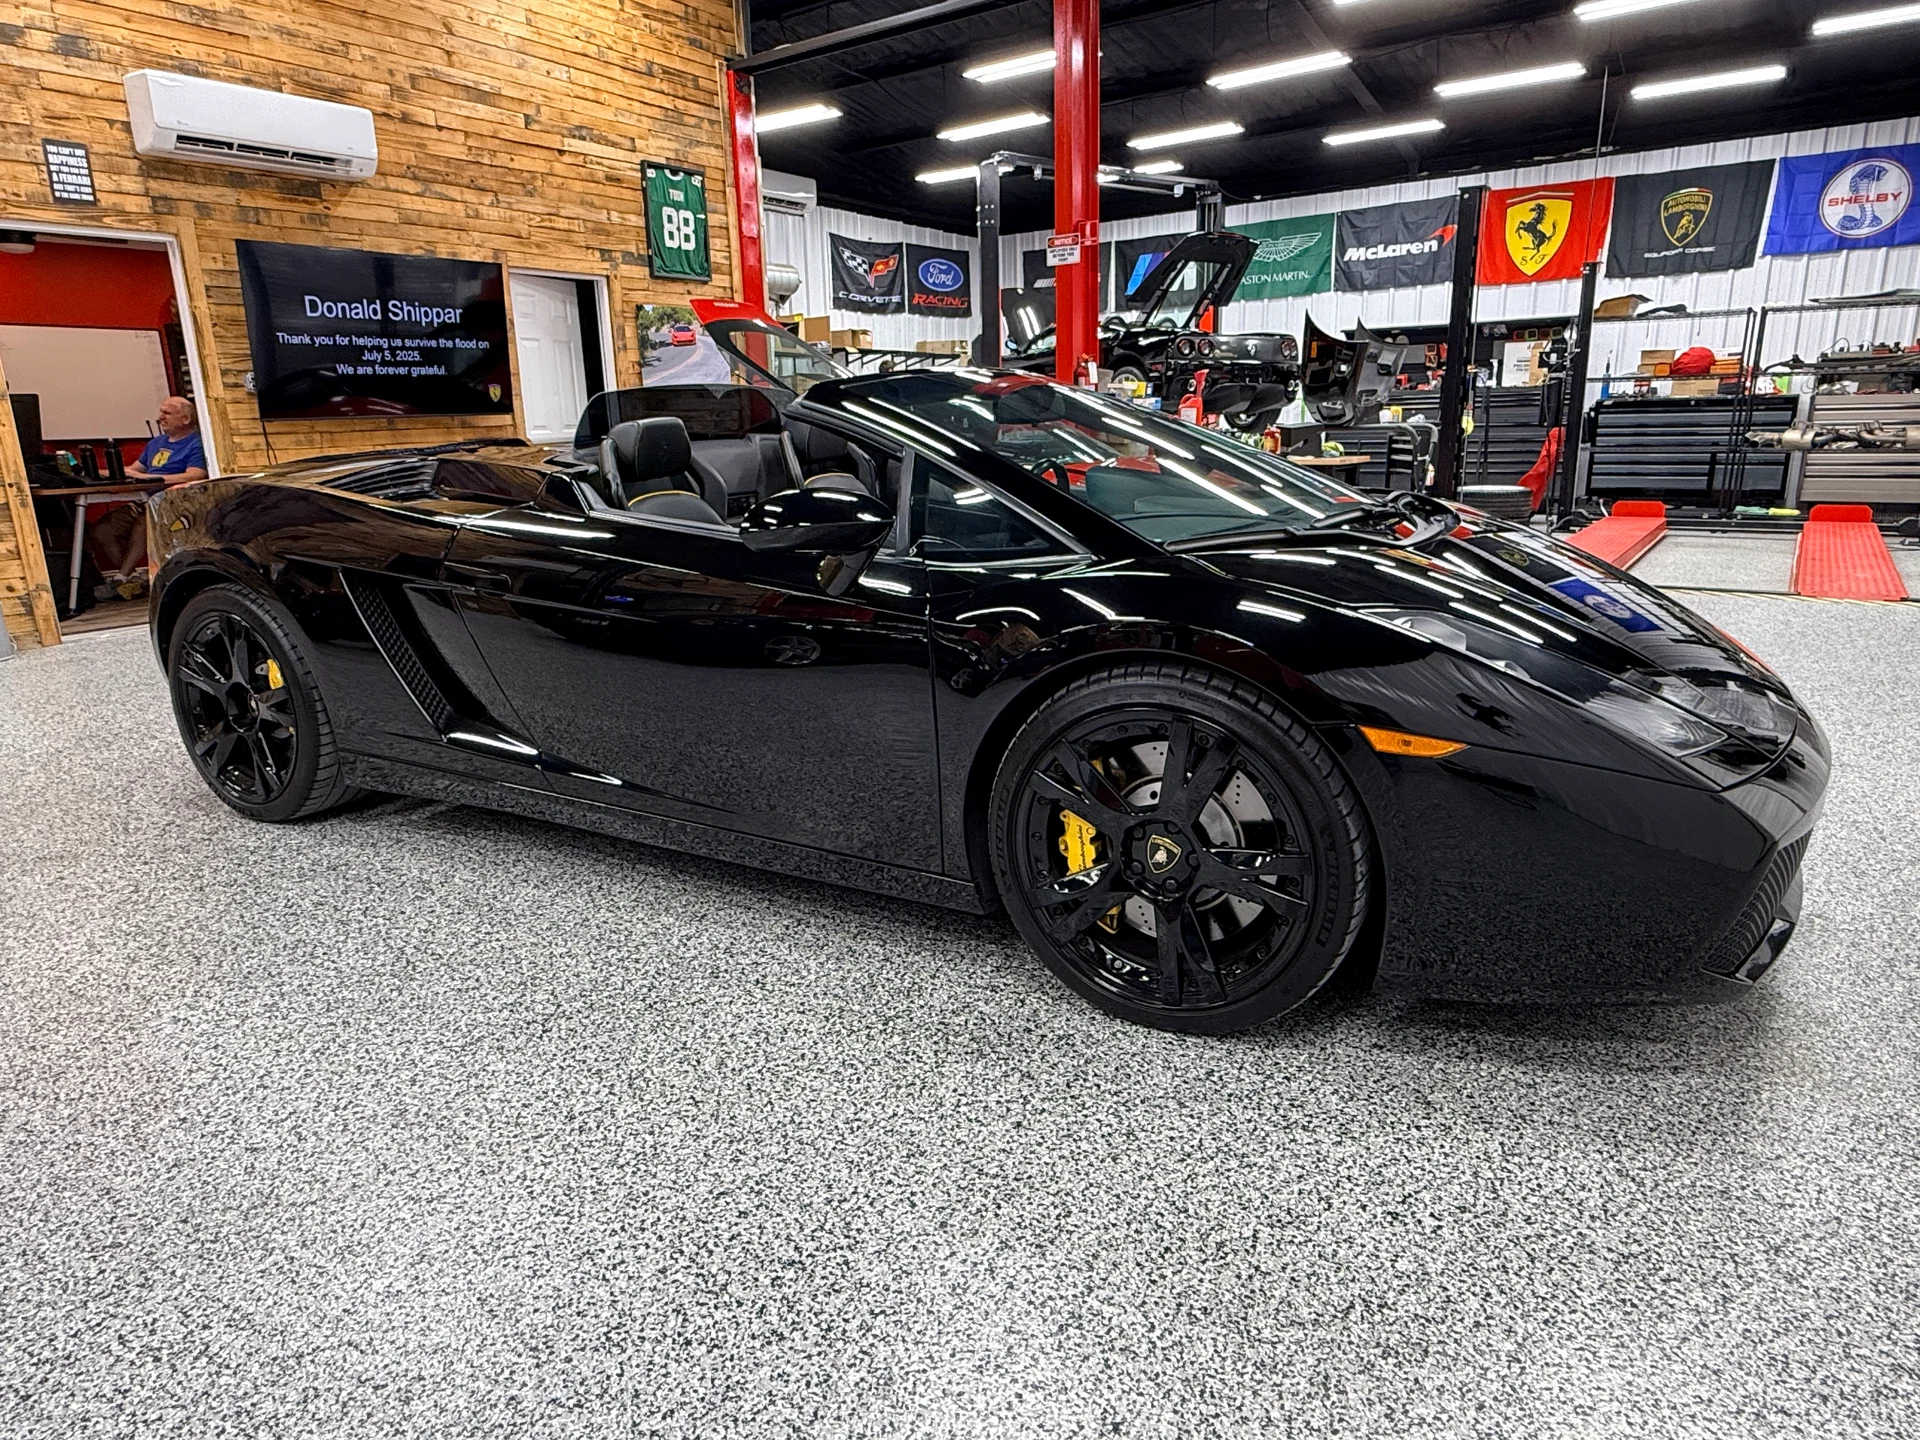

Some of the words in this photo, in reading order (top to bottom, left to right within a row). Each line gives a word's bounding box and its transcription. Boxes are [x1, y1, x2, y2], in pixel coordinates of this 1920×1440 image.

[48, 154, 88, 168] HAPPINESS
[59, 173, 92, 186] FERRARI
[1667, 195, 1706, 208] AUTOMOBILI
[1828, 192, 1902, 206] SHELBY
[1664, 203, 1708, 216] LAMBORGHINI
[662, 206, 696, 250] 88
[1054, 238, 1073, 246] NOTICE
[1343, 240, 1438, 262] McLaren
[928, 262, 954, 285] Ford
[1240, 274, 1272, 285] ASTON
[1272, 270, 1308, 282] MARTIN
[839, 291, 902, 304] CORVETTE
[912, 293, 968, 308] RACING
[304, 295, 382, 320] Donald
[388, 300, 463, 327] Shippar
[276, 332, 312, 345] Thank
[314, 335, 334, 348] you
[336, 334, 350, 346] for
[352, 335, 388, 348] helping
[390, 338, 402, 347] us
[404, 338, 438, 348] survive
[438, 338, 454, 348] the
[455, 338, 476, 348] flood
[478, 340, 490, 349] on
[362, 350, 382, 362] July
[384, 351, 394, 362] 5,
[396, 350, 422, 361] 2025.
[336, 364, 354, 374] We
[356, 366, 373, 375] are
[375, 364, 408, 375] forever
[412, 365, 448, 377] grateful.
